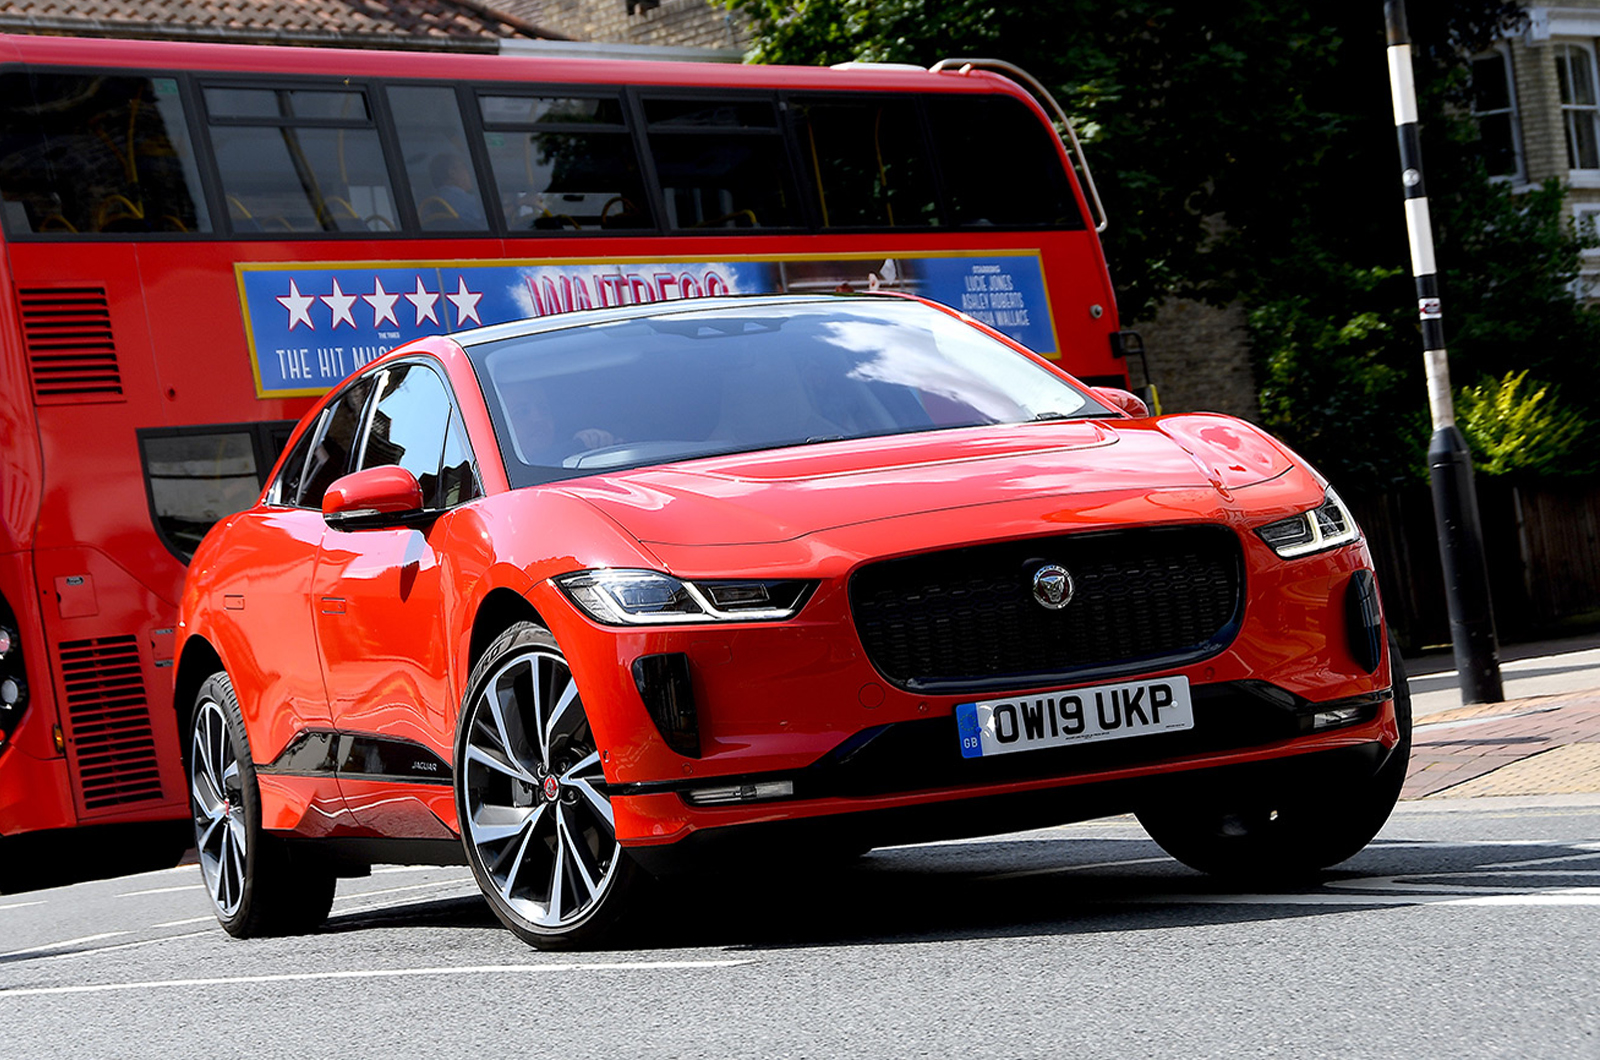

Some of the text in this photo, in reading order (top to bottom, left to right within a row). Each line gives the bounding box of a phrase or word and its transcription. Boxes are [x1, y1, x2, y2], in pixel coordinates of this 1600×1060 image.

[276, 348, 312, 379] THE
[317, 347, 345, 378] HIT
[993, 684, 1173, 744] OW19 UKP
[963, 736, 978, 749] GB
[411, 761, 437, 771] JAGUAR
